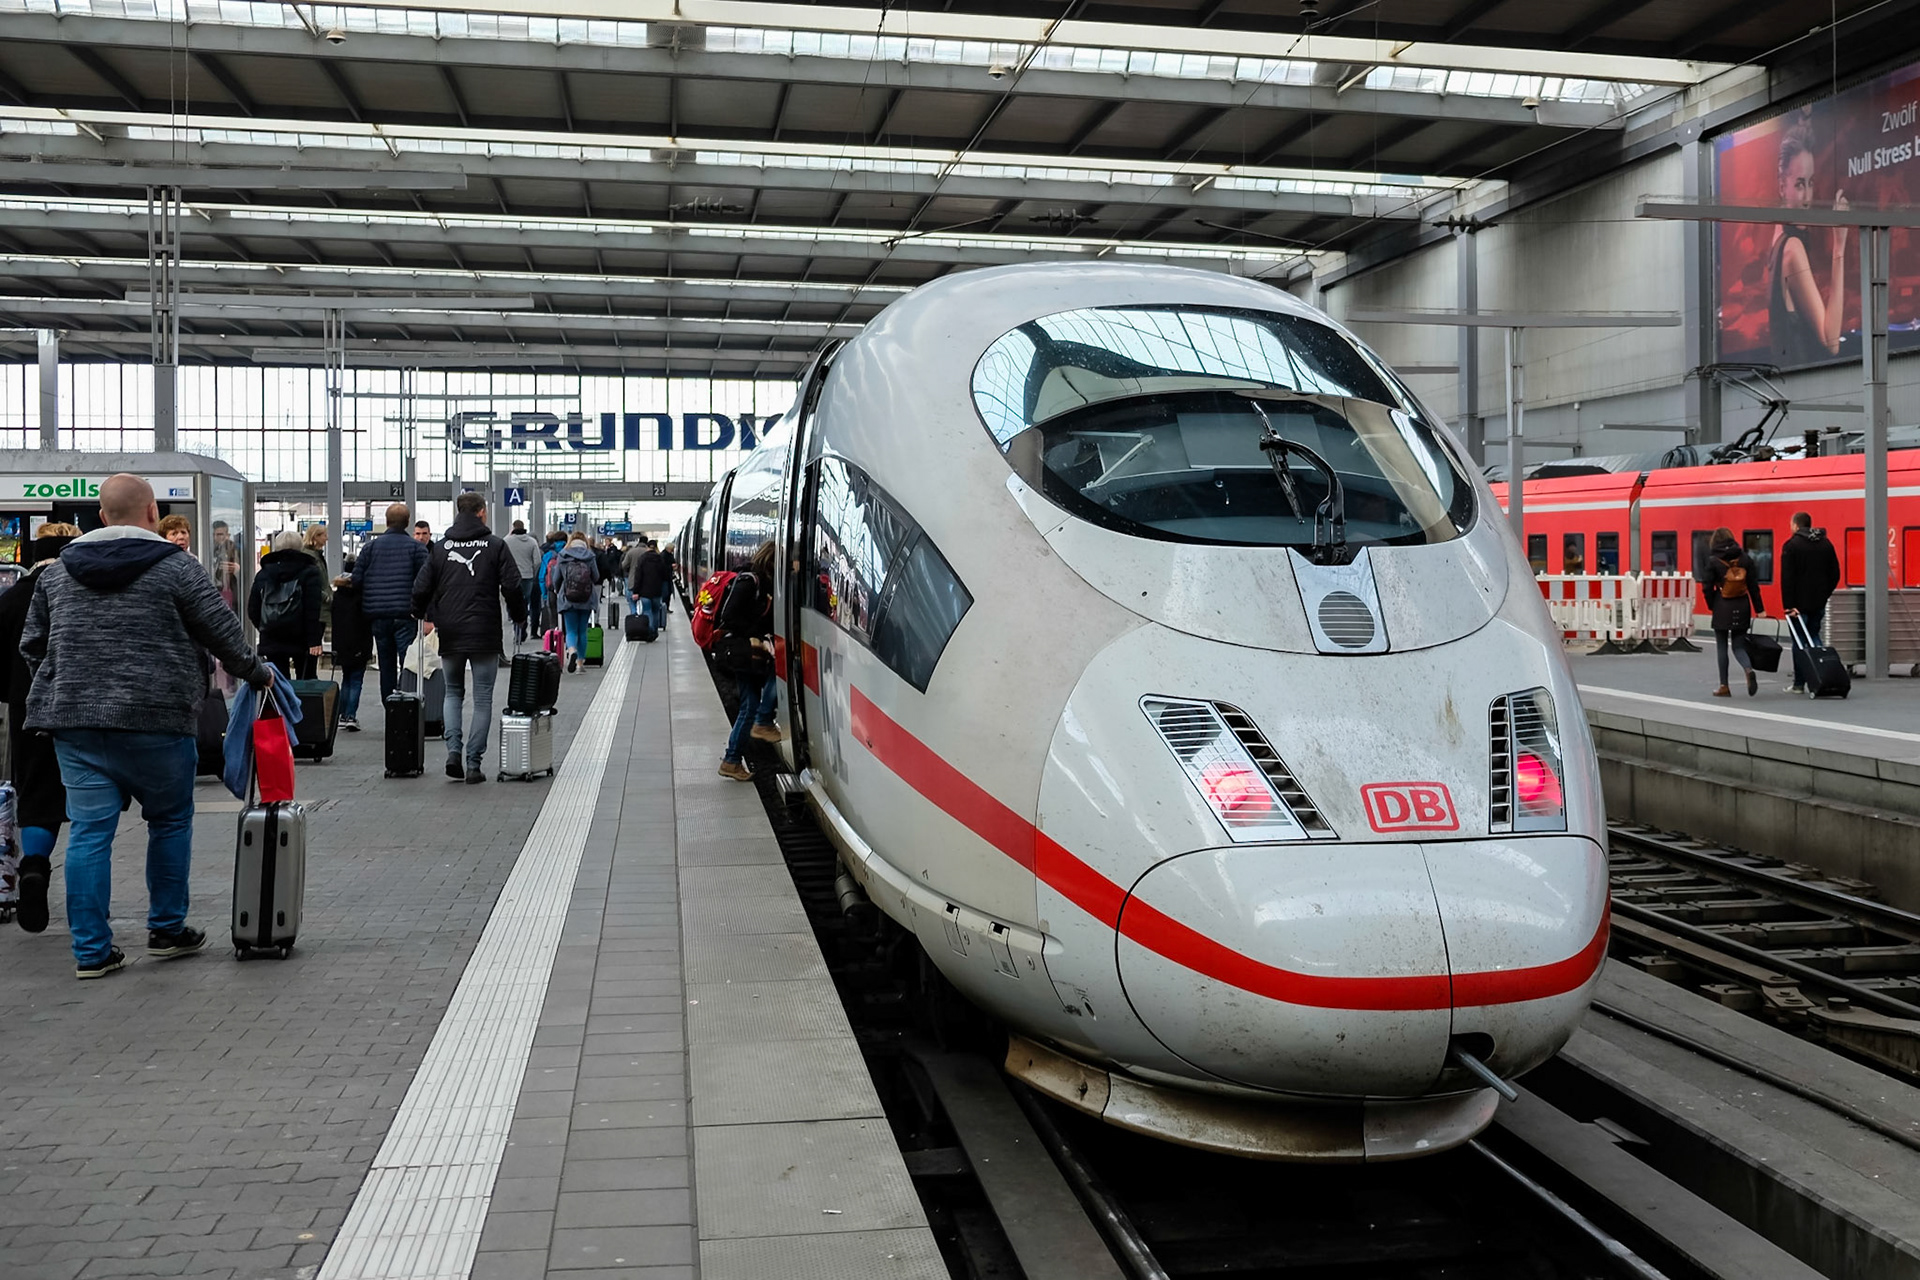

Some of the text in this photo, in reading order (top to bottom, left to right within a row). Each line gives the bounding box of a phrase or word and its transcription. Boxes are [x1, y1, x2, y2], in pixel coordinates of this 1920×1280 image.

[1881, 100, 1918, 133] Zwölf
[1848, 151, 1872, 178] Null
[1874, 142, 1912, 169] Stress
[450, 411, 784, 450] GRUNDI
[23, 478, 100, 497] zoells
[392, 487, 402, 496] 21
[509, 488, 521, 503] A
[653, 487, 665, 496] 23
[567, 513, 576, 523] B
[1888, 527, 1896, 547] 2
[1372, 788, 1448, 825] DB
